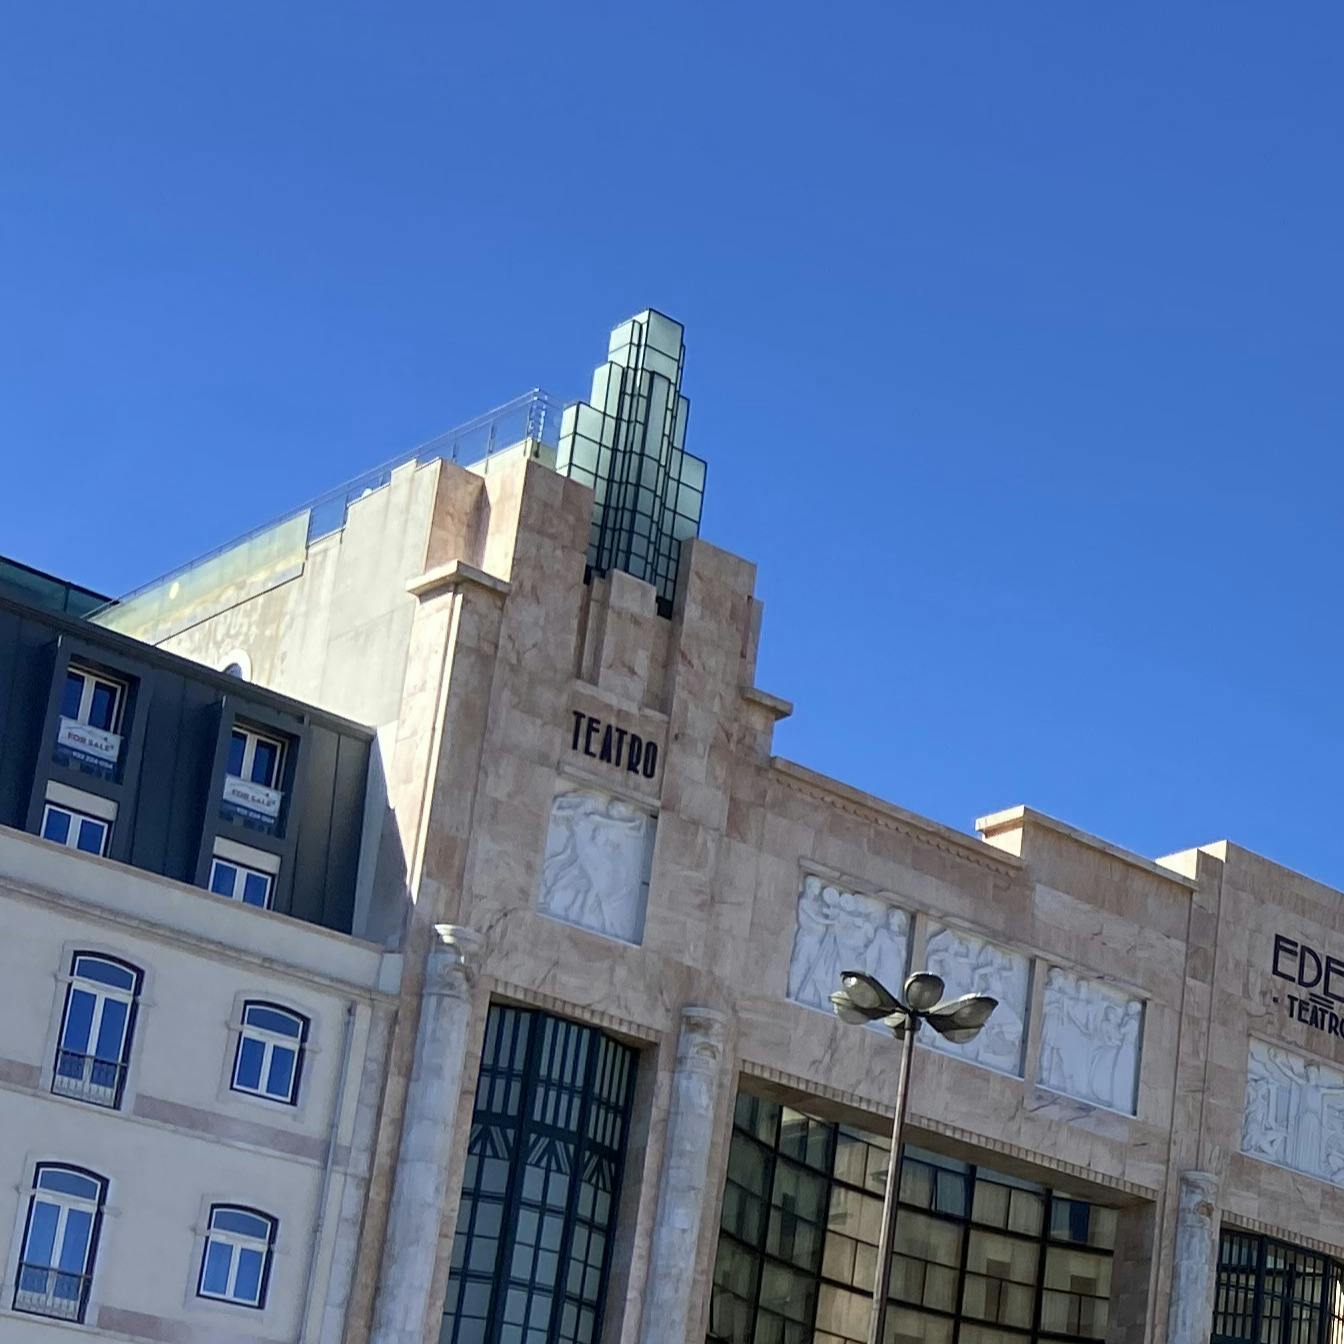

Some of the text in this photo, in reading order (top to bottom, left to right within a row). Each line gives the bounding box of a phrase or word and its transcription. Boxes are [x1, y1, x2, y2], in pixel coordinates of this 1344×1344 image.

[67, 731, 111, 752] FOR SALE
[571, 709, 658, 779] TEATRO
